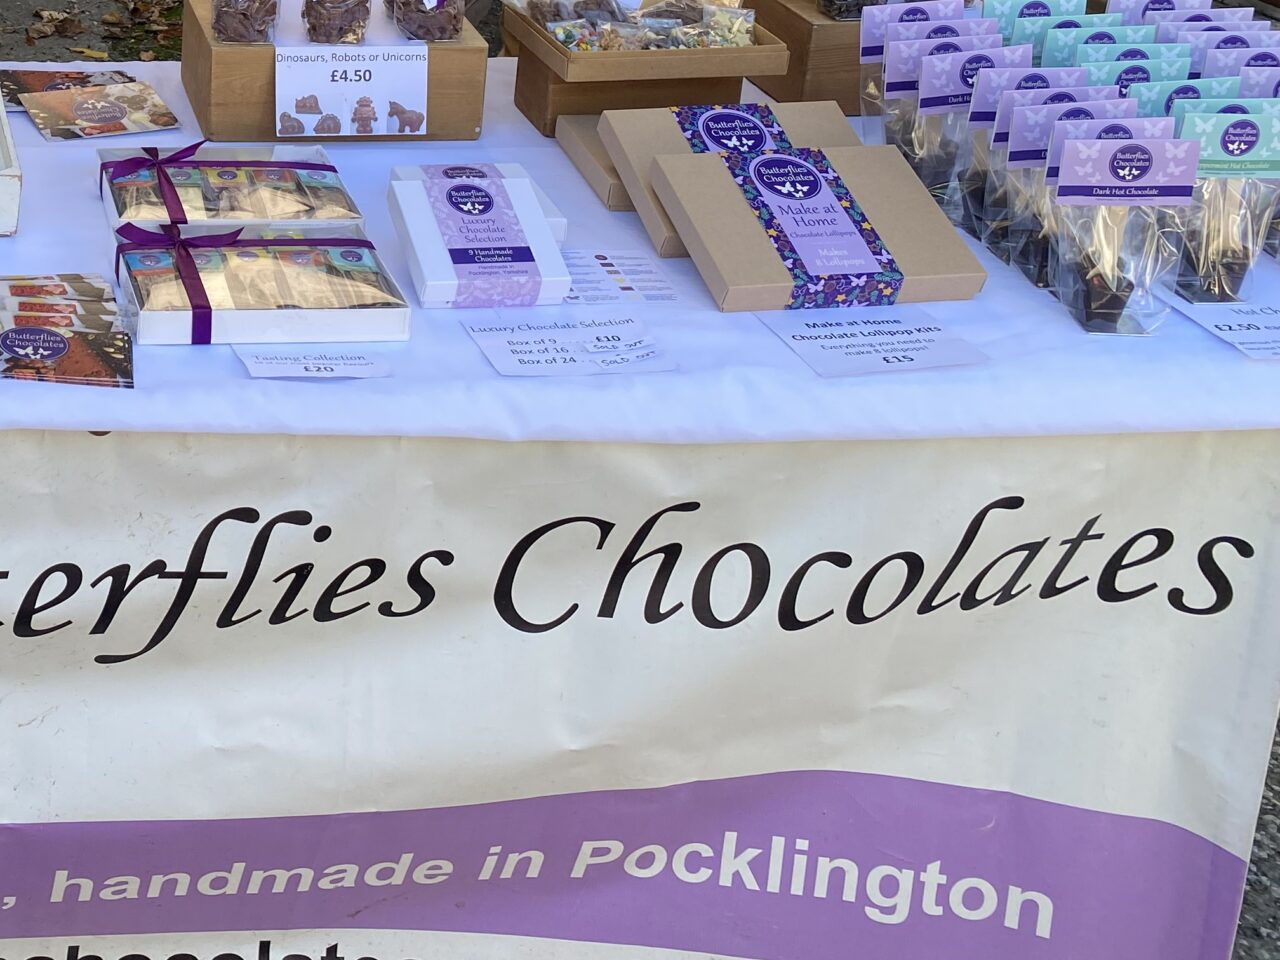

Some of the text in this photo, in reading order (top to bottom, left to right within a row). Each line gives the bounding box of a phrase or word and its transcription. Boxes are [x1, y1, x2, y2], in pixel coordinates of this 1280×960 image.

[276, 53, 427, 63] Dinosaurs, Robots or Unicorns
[330, 69, 372, 82] £4.50
[708, 120, 754, 130] Butterflies
[712, 128, 760, 136] Chocolates
[1228, 127, 1257, 135] Butterflies
[1116, 152, 1149, 161] Butterflies
[759, 165, 808, 175] Butterflies
[764, 173, 814, 182] Chocolates
[451, 190, 486, 199] Butterflies
[778, 203, 839, 216] Make at
[461, 217, 496, 226] Luxury
[792, 216, 838, 228] Home
[459, 225, 505, 233] Chocolate
[465, 235, 507, 243] Selection
[790, 230, 857, 239] Chocolate Lollipops
[818, 248, 848, 257] Makes
[470, 318, 635, 334] Luxury Chocolate Selection
[804, 321, 843, 329] Make
[8, 333, 61, 342] Butterflies
[792, 325, 942, 341] Chocolate Lollipop Kits
[6, 339, 64, 348] Chocolates
[820, 341, 874, 351] Everything
[844, 349, 871, 357] make
[562, 356, 577, 364] 24
[882, 355, 915, 364] £15
[492, 495, 1255, 634] Chocolates
[50, 852, 455, 905] handmade
[477, 844, 542, 882] in
[570, 830, 1055, 939] Pocklington
